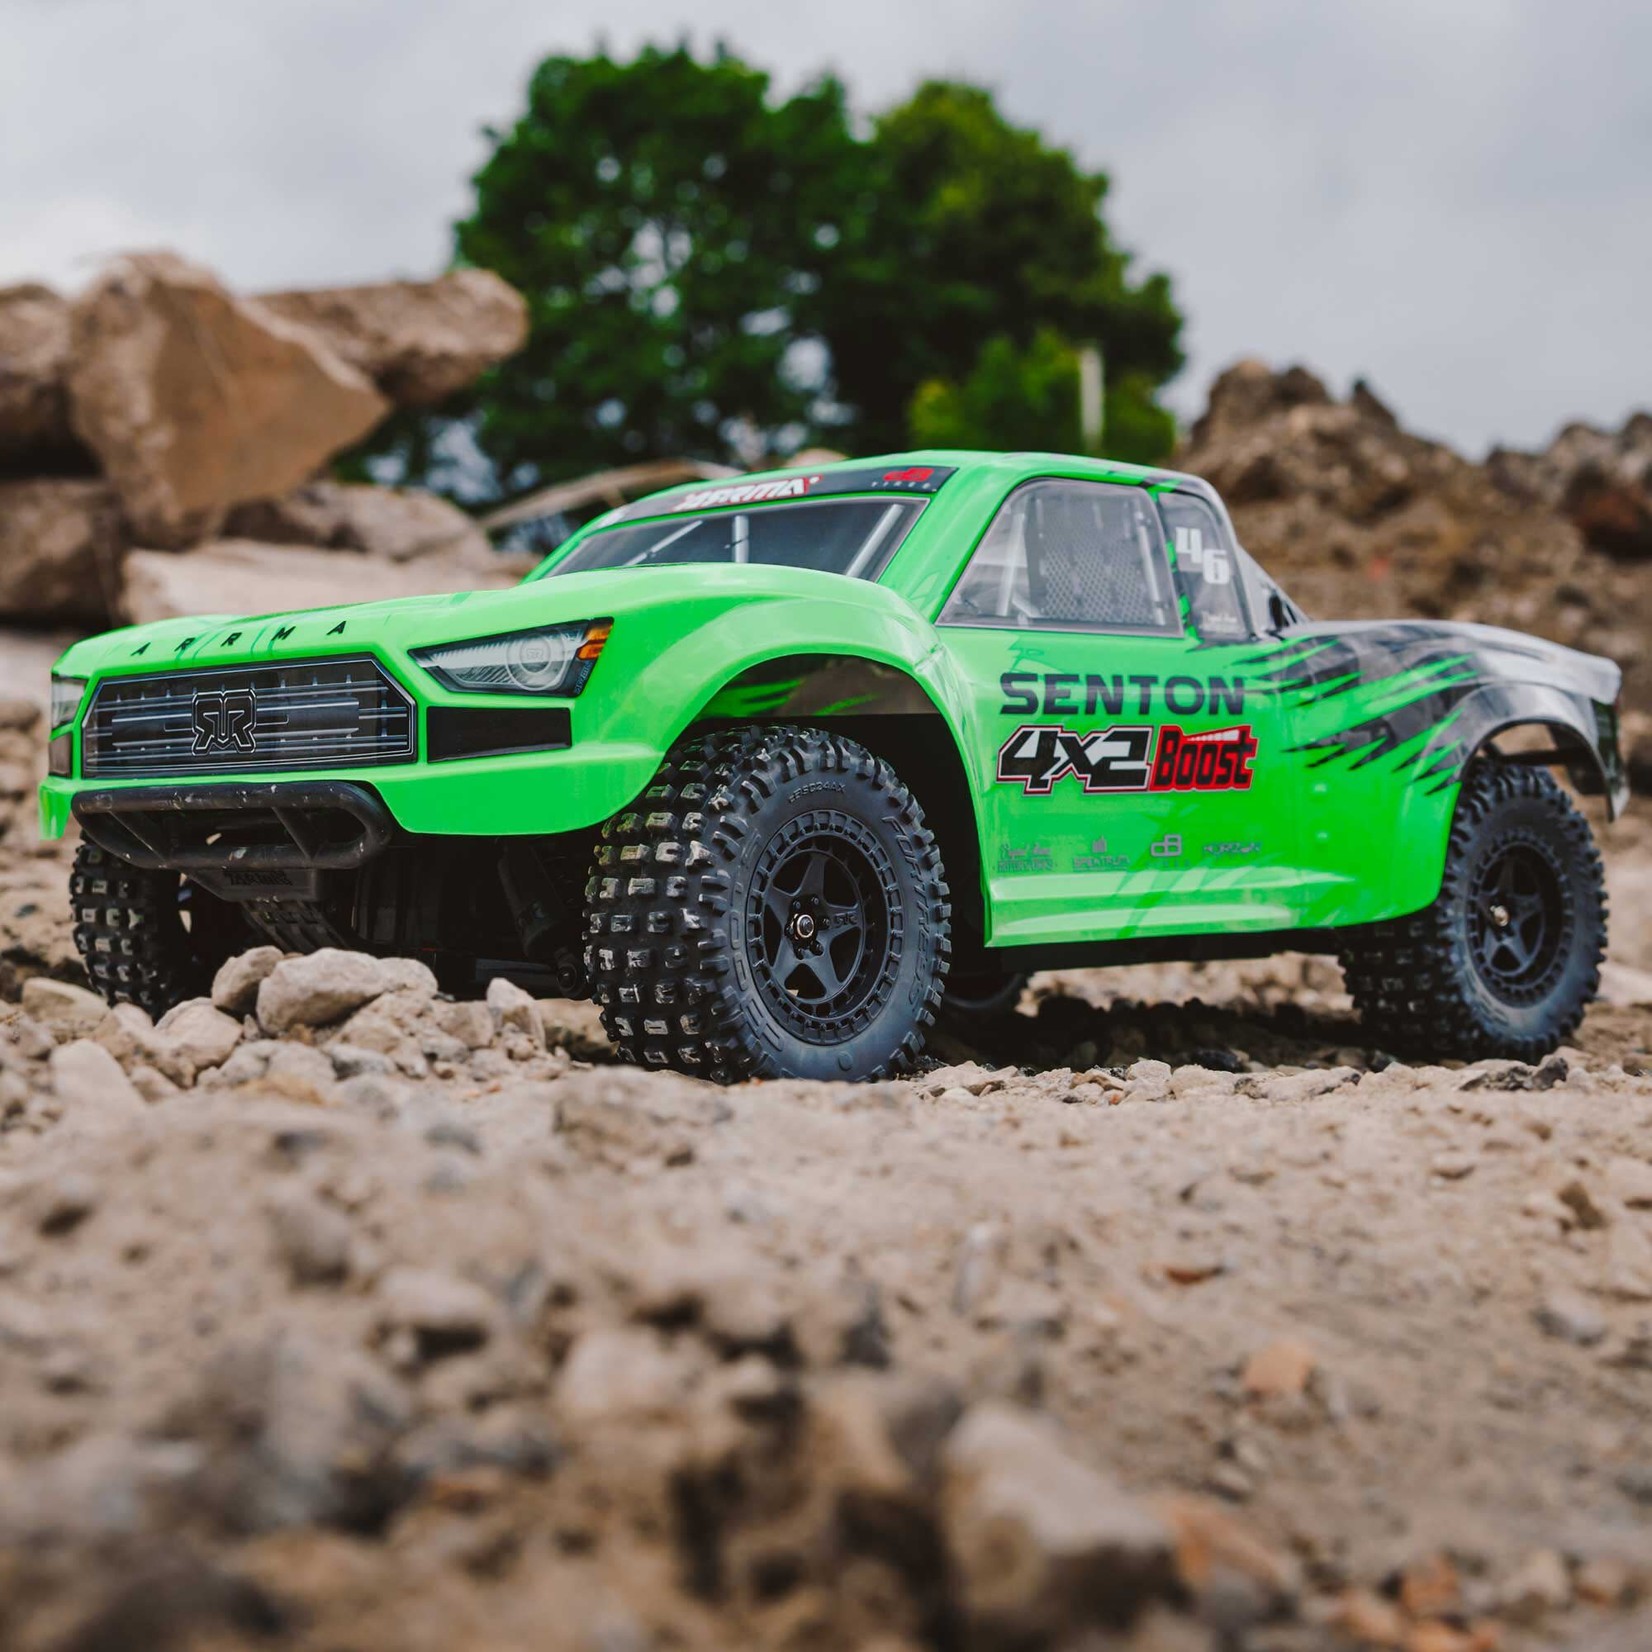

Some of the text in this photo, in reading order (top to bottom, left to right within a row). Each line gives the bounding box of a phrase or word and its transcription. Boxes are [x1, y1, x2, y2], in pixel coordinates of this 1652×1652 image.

[1175, 526, 1231, 585] 46
[131, 620, 347, 656] ARRMA
[1000, 672, 1245, 716] SENTON
[996, 725, 1258, 796] 4x2 Boost
